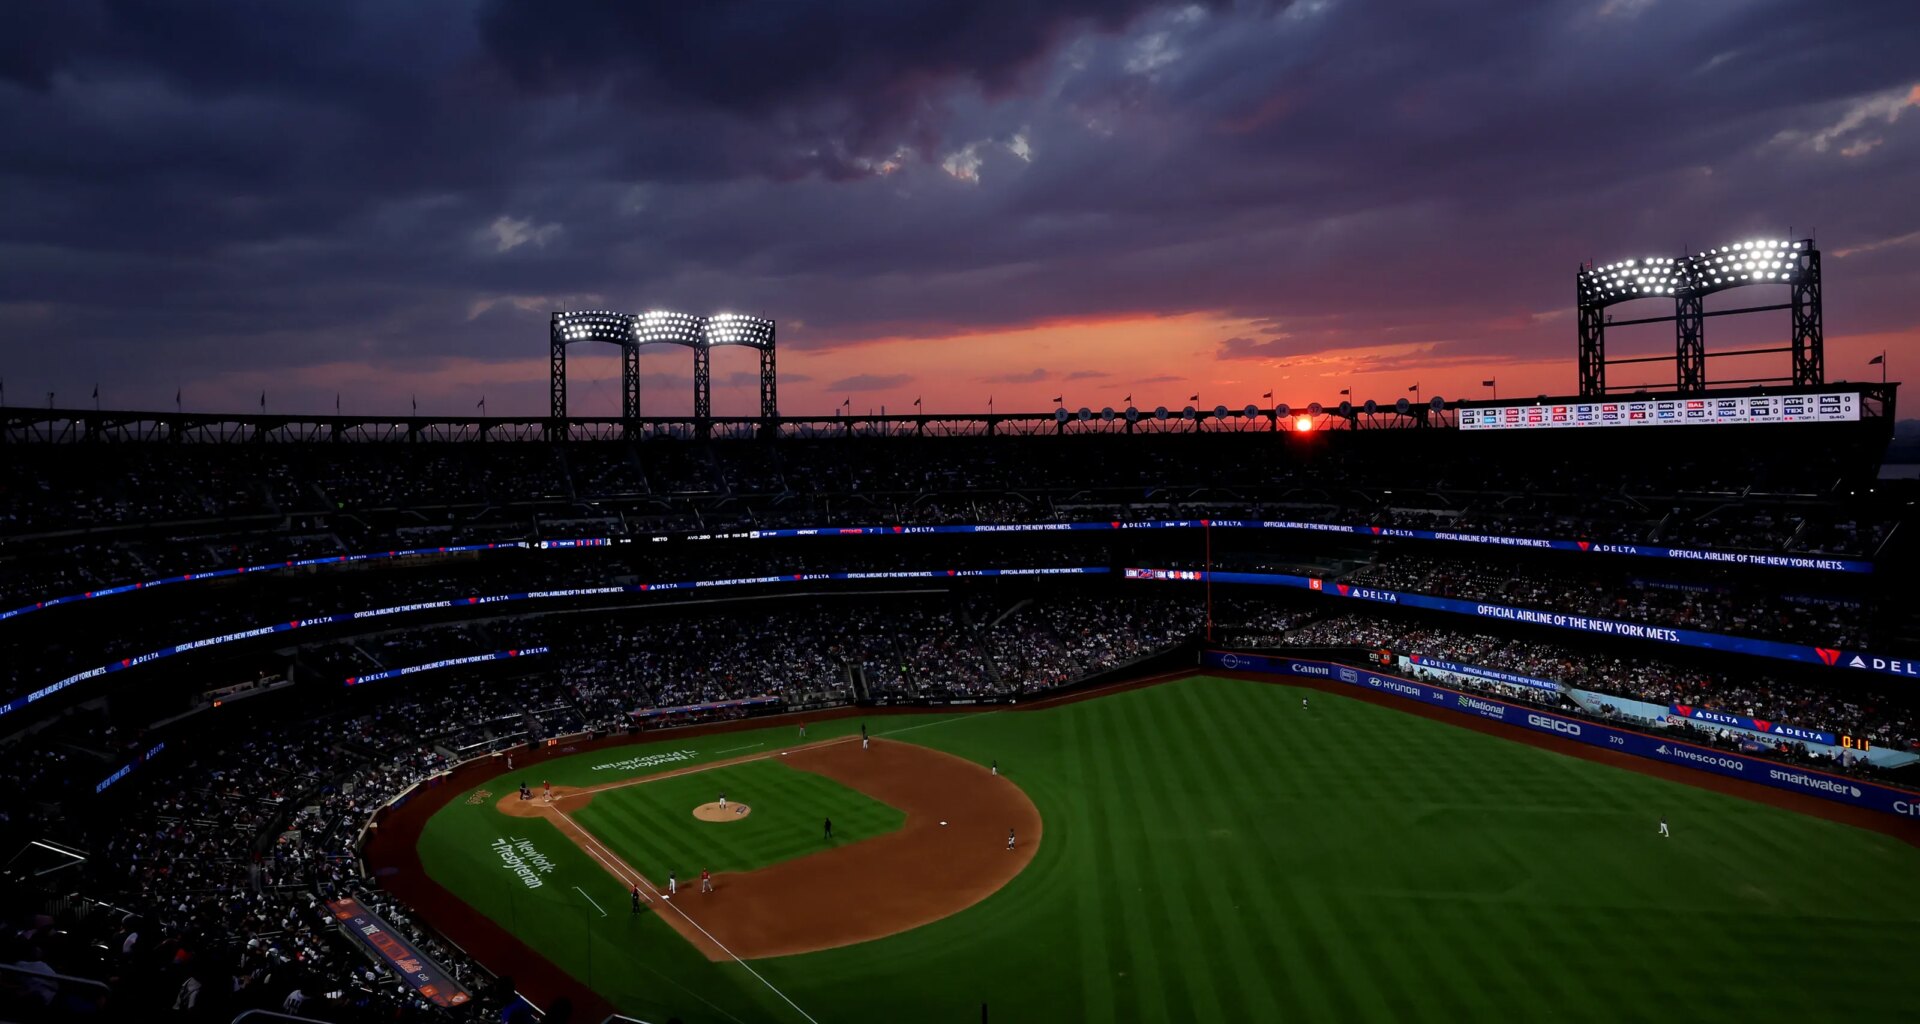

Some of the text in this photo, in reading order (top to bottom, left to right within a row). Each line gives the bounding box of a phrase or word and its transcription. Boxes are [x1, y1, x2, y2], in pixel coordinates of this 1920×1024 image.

[1603, 545, 1636, 553] DELTA
[1669, 549, 1844, 570] OFFICIAL AIRLINE OF THE NEW YORK METS.
[487, 594, 509, 603] DELTA
[1362, 590, 1396, 601] DELTA
[354, 610, 375, 618] OFFICIAL
[309, 616, 333, 626] DELTA
[1477, 605, 1679, 642] OFFICIAL AIRLINE OF THE NEW YORK METS.
[176, 642, 193, 653] OFFICIAL
[194, 638, 215, 648] AIRLINE
[223, 634, 233, 642] THE
[234, 631, 246, 640] NEW
[246, 629, 260, 637] YORK
[139, 652, 159, 663] DELTA
[402, 666, 421, 674] OFFICIAL
[422, 662, 439, 671] AIRLINE
[1292, 663, 1329, 675] Canon
[1429, 660, 1456, 670] DELTA
[1463, 667, 1482, 675] OFFICIAL
[365, 672, 388, 681] DELTA
[1383, 681, 1420, 697] HYUNDAI
[1468, 697, 1504, 715] National
[1706, 712, 1738, 724] DELTA
[1528, 714, 1580, 736] GEICO
[1786, 728, 1822, 740] DELTA
[1609, 736, 1624, 745] 370
[1842, 735, 1869, 751] 0:11
[592, 751, 682, 770] Presbyterian
[1674, 747, 1743, 772] Invesco QQQ
[1770, 769, 1849, 795] smartwater
[497, 844, 543, 888] Presbyterian
